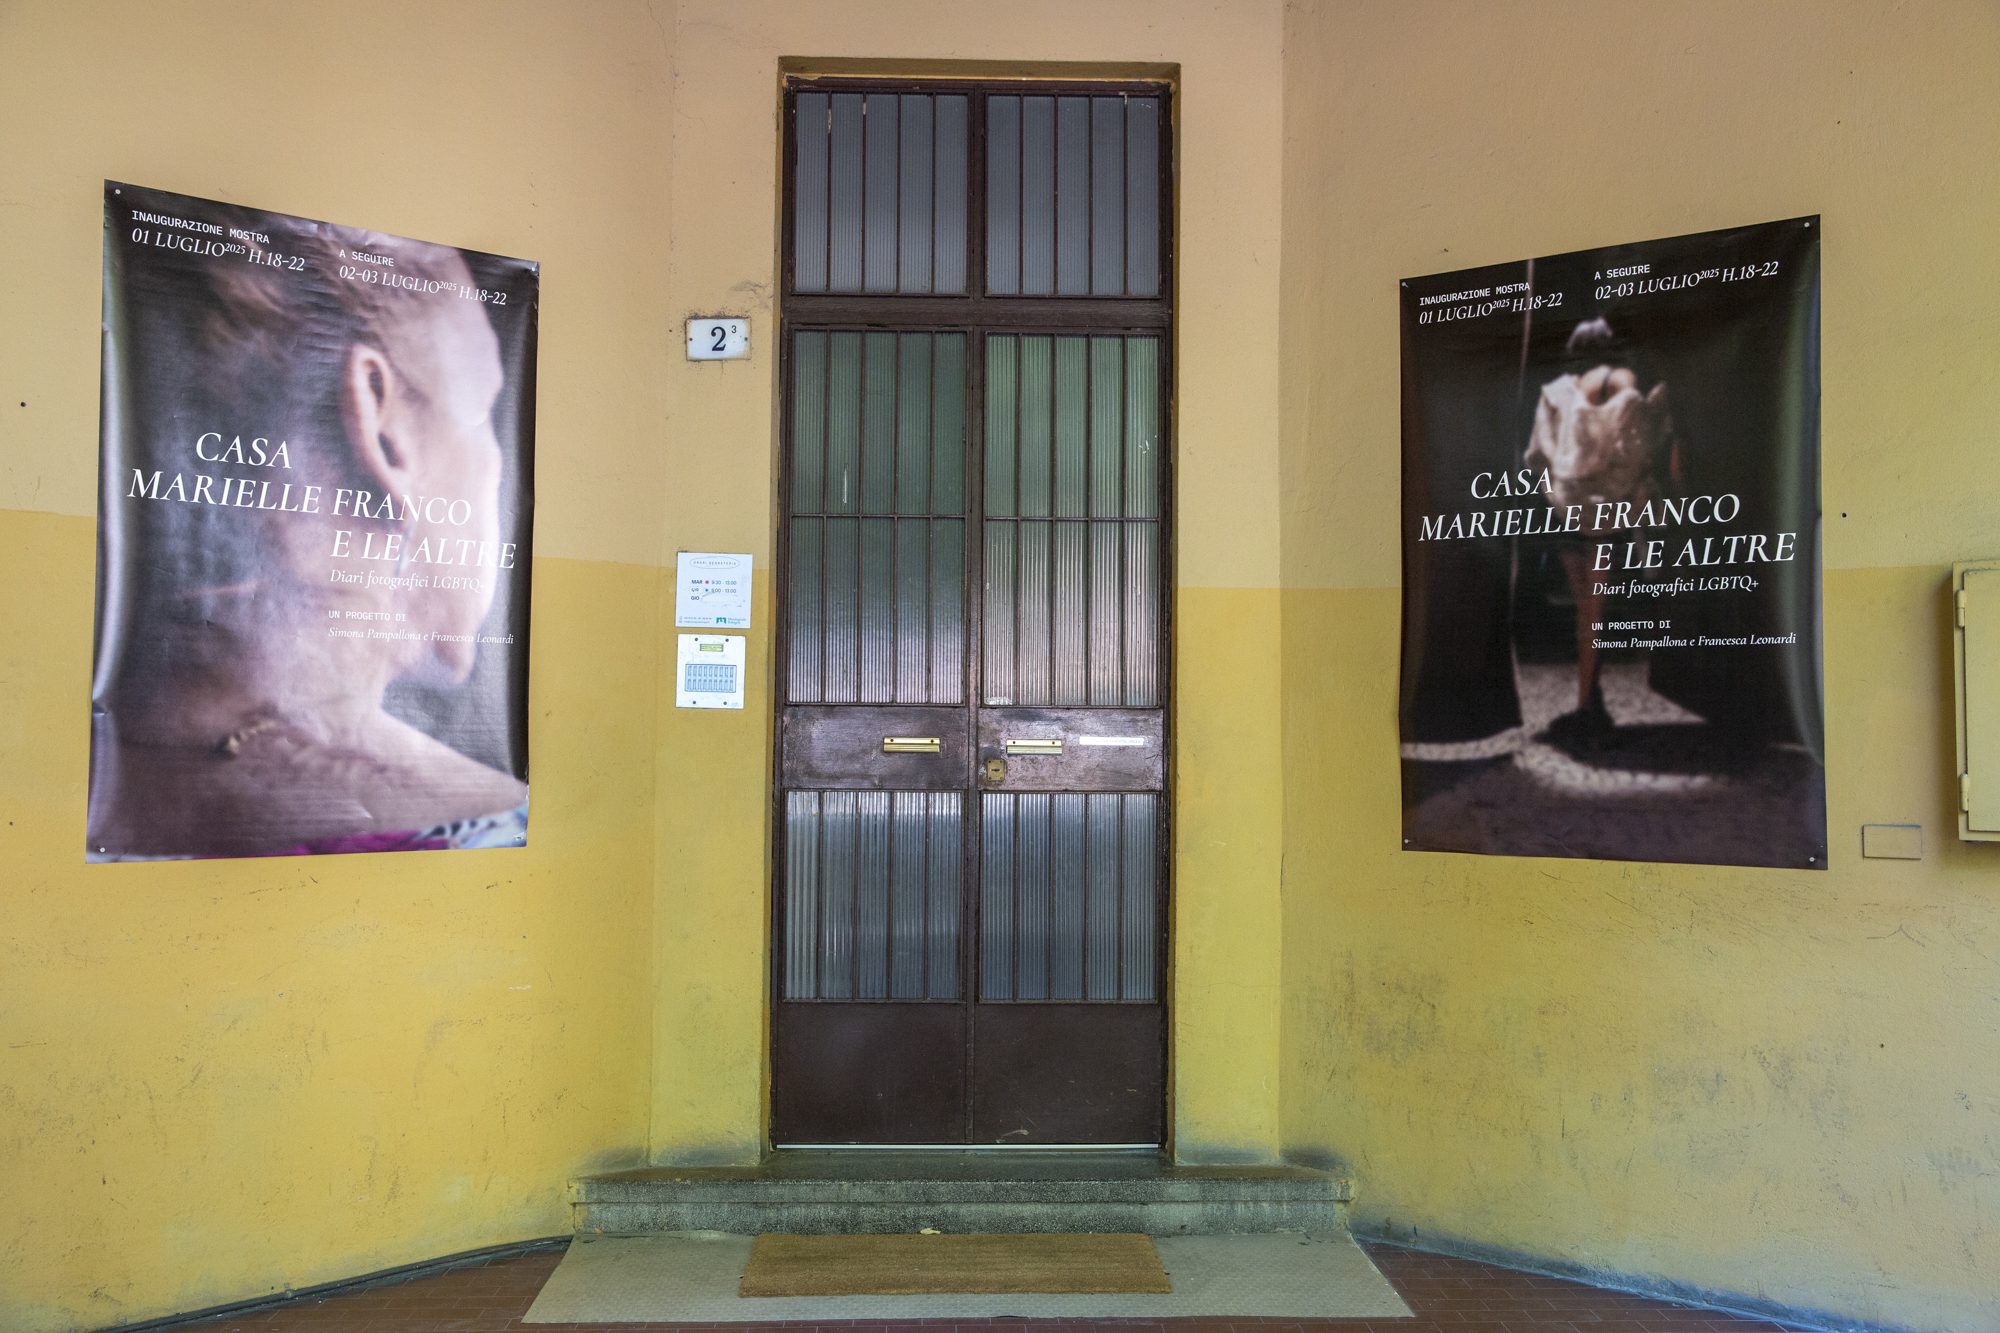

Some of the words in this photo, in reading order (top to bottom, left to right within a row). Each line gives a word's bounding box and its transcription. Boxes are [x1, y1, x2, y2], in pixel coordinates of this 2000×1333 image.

[131, 227, 150, 245] 01
[132, 210, 223, 236] INAUGURAZIONE
[229, 228, 270, 244] MOSTRA
[339, 249, 346, 259] A
[351, 251, 395, 267] SEGUIRE
[339, 265, 378, 284] 02-03
[1594, 271, 1601, 281] A
[1606, 264, 1651, 279] SEGUIRE
[1419, 287, 1491, 306] INAUGURAZIONE
[1495, 282, 1531, 295] MOSTRA
[1595, 282, 1634, 300] 02-03
[1419, 310, 1434, 325] 01
[195, 432, 293, 469] CASA
[1470, 467, 1554, 499] CASA
[126, 468, 322, 514] MARIELLE
[330, 488, 472, 526] FRANCO
[1418, 504, 1583, 542] MARIELLE
[1591, 493, 1740, 531] FRANCO
[330, 529, 352, 558] E
[361, 532, 403, 562] LE
[410, 536, 517, 570] ALTRE
[1592, 543, 1614, 571] E
[1622, 540, 1665, 570] LE
[1672, 532, 1797, 567] ALTRE
[329, 569, 364, 584] Diari
[365, 569, 429, 592] fotografici
[432, 575, 486, 594] LGBTQ+
[1592, 582, 1626, 596] Diari
[1627, 577, 1695, 599] fotografici
[1698, 575, 1759, 592] LGBTQ+
[328, 610, 341, 619] UN
[345, 611, 391, 621] PROGETTO
[395, 613, 407, 622] DI
[1591, 622, 1604, 631] UN
[1608, 620, 1654, 631] PROGETTO
[1659, 620, 1671, 629] DI
[328, 627, 365, 639] Simona
[367, 628, 421, 643] Pampallona
[431, 631, 474, 643] Francesca
[476, 633, 515, 645] Leonardi
[1591, 638, 1628, 649] Simona
[1630, 635, 1687, 650] Pampallona
[1689, 638, 1695, 646] e
[1697, 635, 1747, 646] Francesca
[1750, 632, 1797, 646] Leonardi
